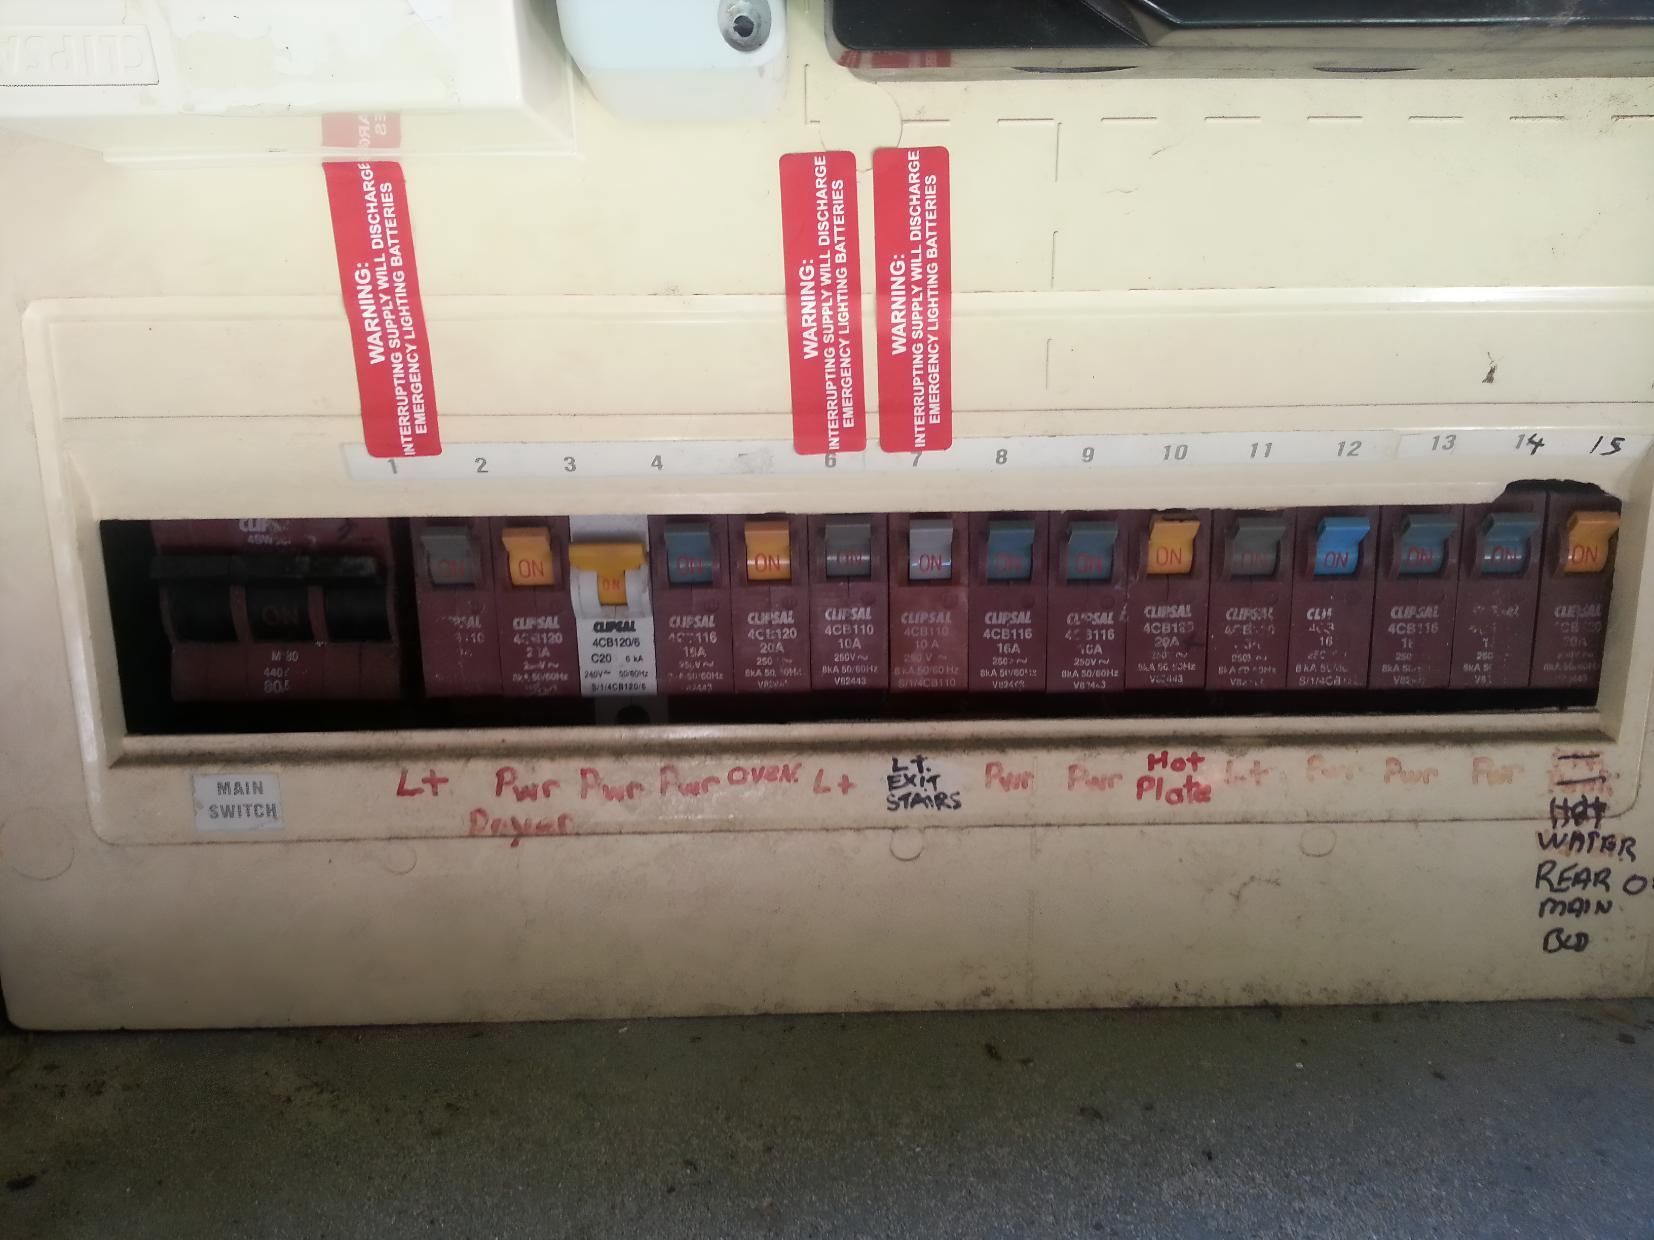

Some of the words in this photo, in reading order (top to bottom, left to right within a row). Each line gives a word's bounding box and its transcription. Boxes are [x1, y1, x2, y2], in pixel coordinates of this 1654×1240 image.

[357, 162, 384, 250] DISCHARGE
[814, 155, 830, 246] DISCHARGE
[908, 150, 922, 241] DISCHARGE
[380, 182, 403, 267] BATTERIES
[832, 179, 847, 264] BATTERIES
[925, 175, 938, 258] BATTERIES
[374, 253, 392, 290] WILL
[819, 250, 832, 287] WILL
[910, 244, 923, 282] WILL
[355, 262, 385, 365] WARNING:
[393, 272, 415, 339] LIGHTING
[799, 259, 819, 360] WARNING:
[835, 268, 850, 334] LIGHTING
[890, 254, 907, 356] WARNING:
[911, 284, 924, 339] SUPPLY
[926, 262, 939, 331] LIGHTING
[379, 294, 401, 349] SUPPLY
[821, 290, 835, 344] SUPPLY
[406, 344, 427, 434] EMERGENCY
[839, 339, 855, 428] EMERGENCY
[912, 343, 926, 448] INTERRUPTING
[927, 335, 940, 424] EMERGENCY
[391, 352, 415, 456] INTERRUPTING
[824, 348, 840, 450] INTERRUPTING
[388, 458, 397, 475] 1
[474, 457, 488, 474] 2
[563, 456, 577, 473] 3
[651, 455, 663, 471] 4
[825, 451, 837, 468] 6
[912, 450, 923, 467] 7
[995, 448, 1008, 465] 8
[1081, 447, 1095, 463] 9
[1161, 444, 1187, 462] 10
[1250, 442, 1273, 458] 11
[1336, 440, 1362, 457] 12
[1431, 434, 1457, 451] 13
[1515, 433, 1545, 455] 14
[1589, 436, 1626, 456] 15
[518, 559, 544, 579] ON
[755, 552, 780, 573] ON
[919, 553, 942, 573] ON
[1075, 553, 1102, 574] ON
[1156, 547, 1182, 566] ON
[1323, 551, 1348, 569] ON
[1570, 544, 1598, 564] ON
[603, 578, 620, 591] ON
[593, 620, 636, 633] CLIPSAL
[825, 607, 872, 621] CLIPSAL
[901, 611, 952, 624] CLIPSAL
[984, 610, 1032, 624] CLIPSAL
[592, 637, 640, 648] 4CB120/6
[760, 643, 785, 654] 20A
[983, 628, 1032, 640] 4CB116
[591, 653, 612, 664] C20
[1147, 750, 1206, 772] Hot
[216, 780, 264, 796] MAIN
[495, 766, 561, 802] Pwr
[580, 767, 646, 802] Pwr
[887, 773, 942, 792] EXIT
[1136, 774, 1212, 806] Plate
[208, 803, 278, 820] SWITCH
[886, 791, 962, 811] STAIRS
[1537, 830, 1637, 863] WATER
[1535, 859, 1612, 893] REAR
